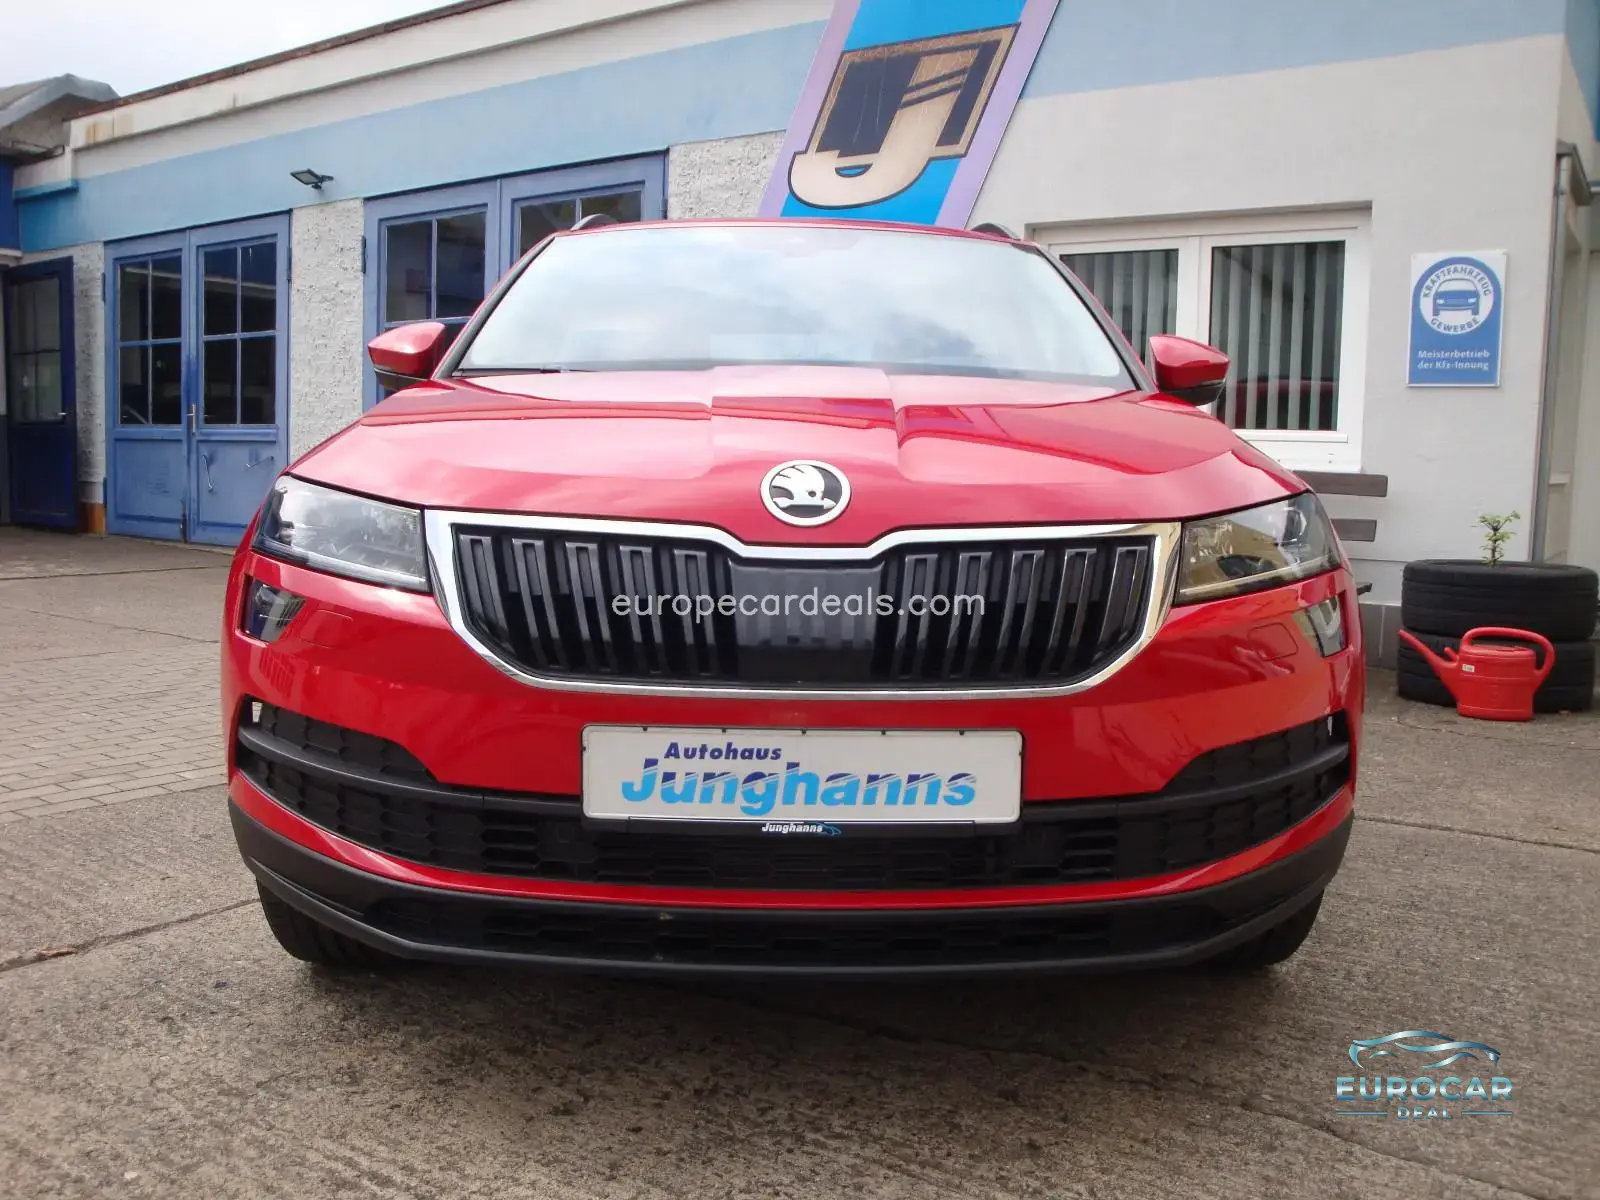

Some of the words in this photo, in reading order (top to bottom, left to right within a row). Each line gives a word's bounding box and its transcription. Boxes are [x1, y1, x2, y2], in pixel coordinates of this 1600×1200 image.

[1422, 265, 1492, 298] KRAFTFAHRZEUG
[1430, 317, 1479, 333] GEWERBE
[1418, 350, 1490, 359] Meisterbetrieb
[1418, 361, 1433, 369] der
[1435, 361, 1489, 371] Kfz-Innung
[663, 742, 782, 761] Autohaus
[621, 758, 978, 817] Junghanns
[761, 822, 823, 834] Junghanns
